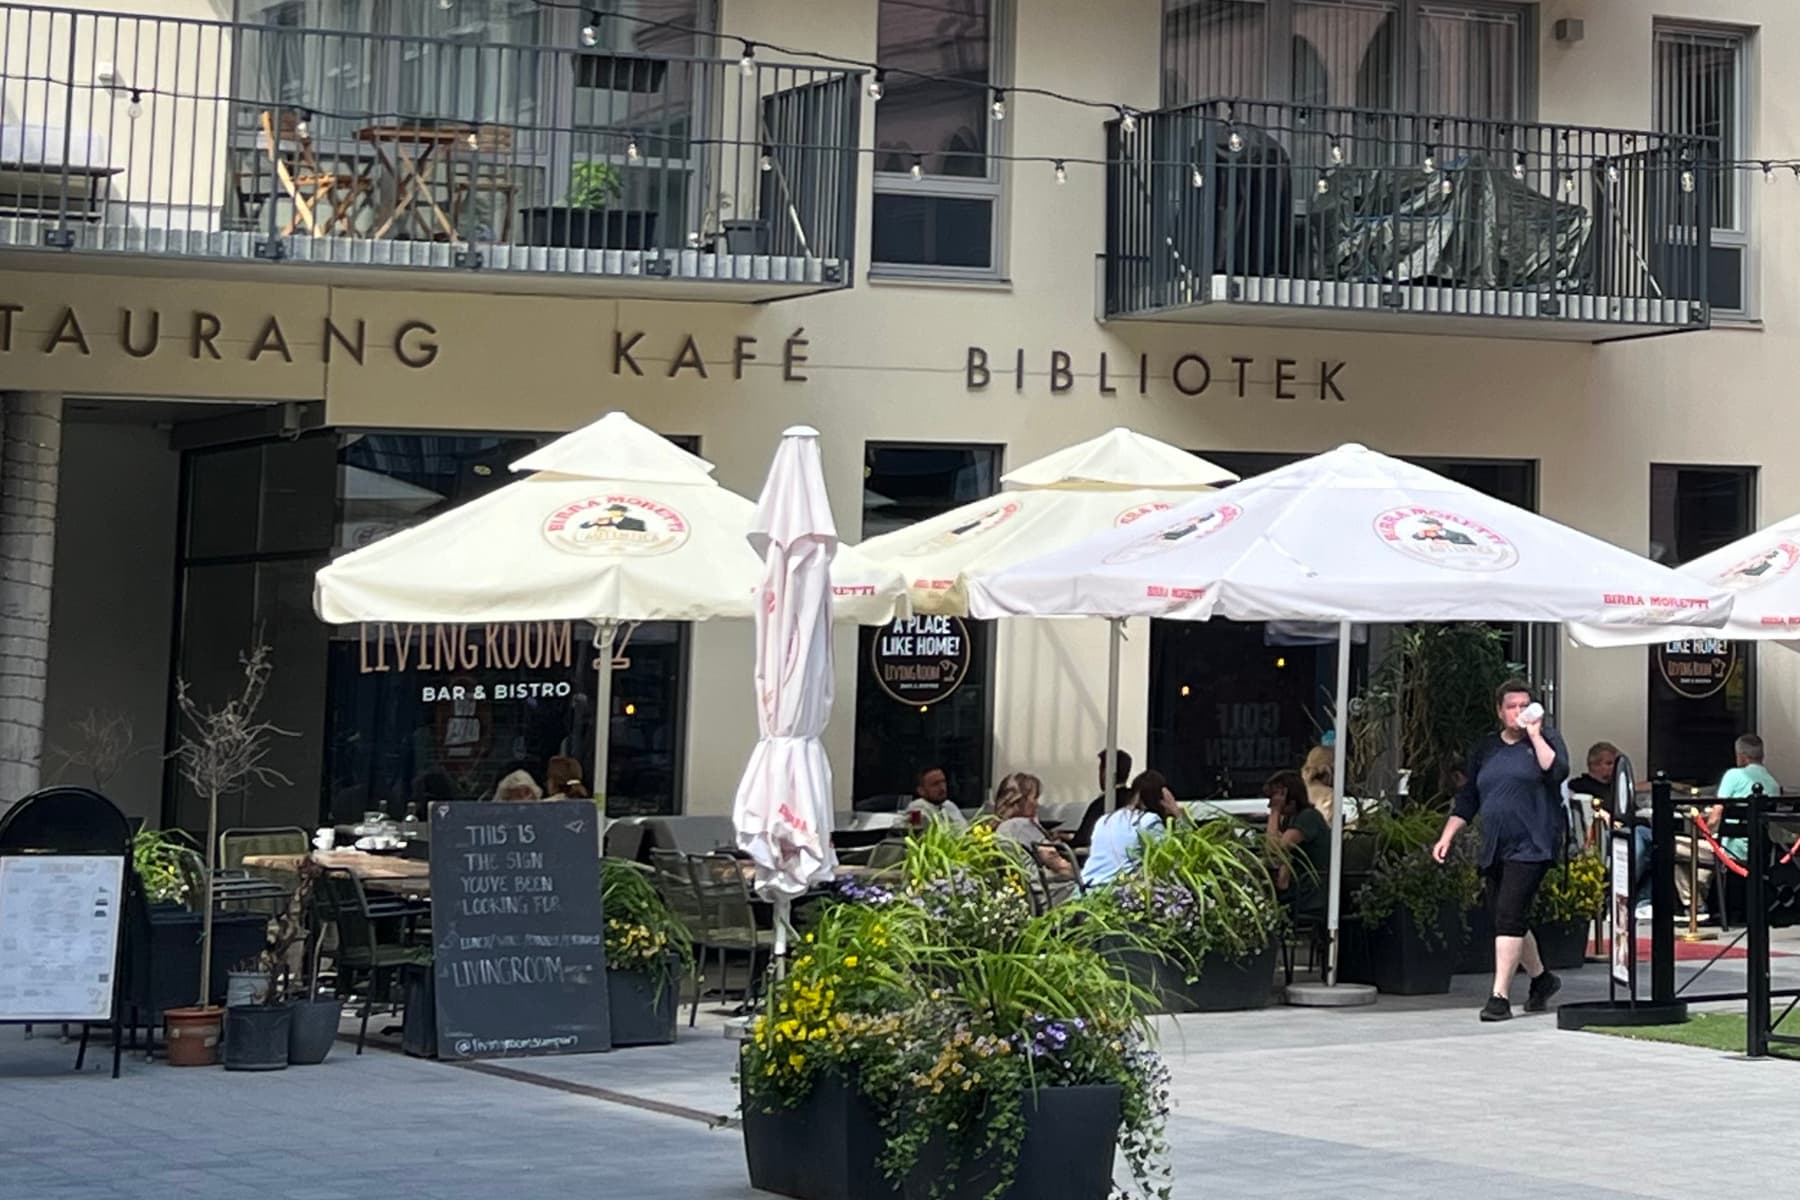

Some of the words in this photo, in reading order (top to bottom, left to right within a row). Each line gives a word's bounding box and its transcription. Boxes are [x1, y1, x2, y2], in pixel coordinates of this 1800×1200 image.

[611, 327, 810, 383] KAFÉ
[965, 346, 1347, 401] BIBLIOTEK
[1603, 594, 1645, 606] BIRRA
[1649, 596, 1710, 610] MORETTI
[893, 616, 903, 634] A
[907, 614, 951, 634] PLACE
[882, 636, 912, 656] LIKE
[916, 636, 960, 656] HOME!
[422, 686, 465, 701] BAR
[473, 686, 486, 700] &
[494, 681, 571, 700] BISTRO
[464, 824, 508, 846] THIS
[518, 823, 537, 845] IS
[507, 851, 544, 870] SIGN
[515, 875, 553, 892] BEEN
